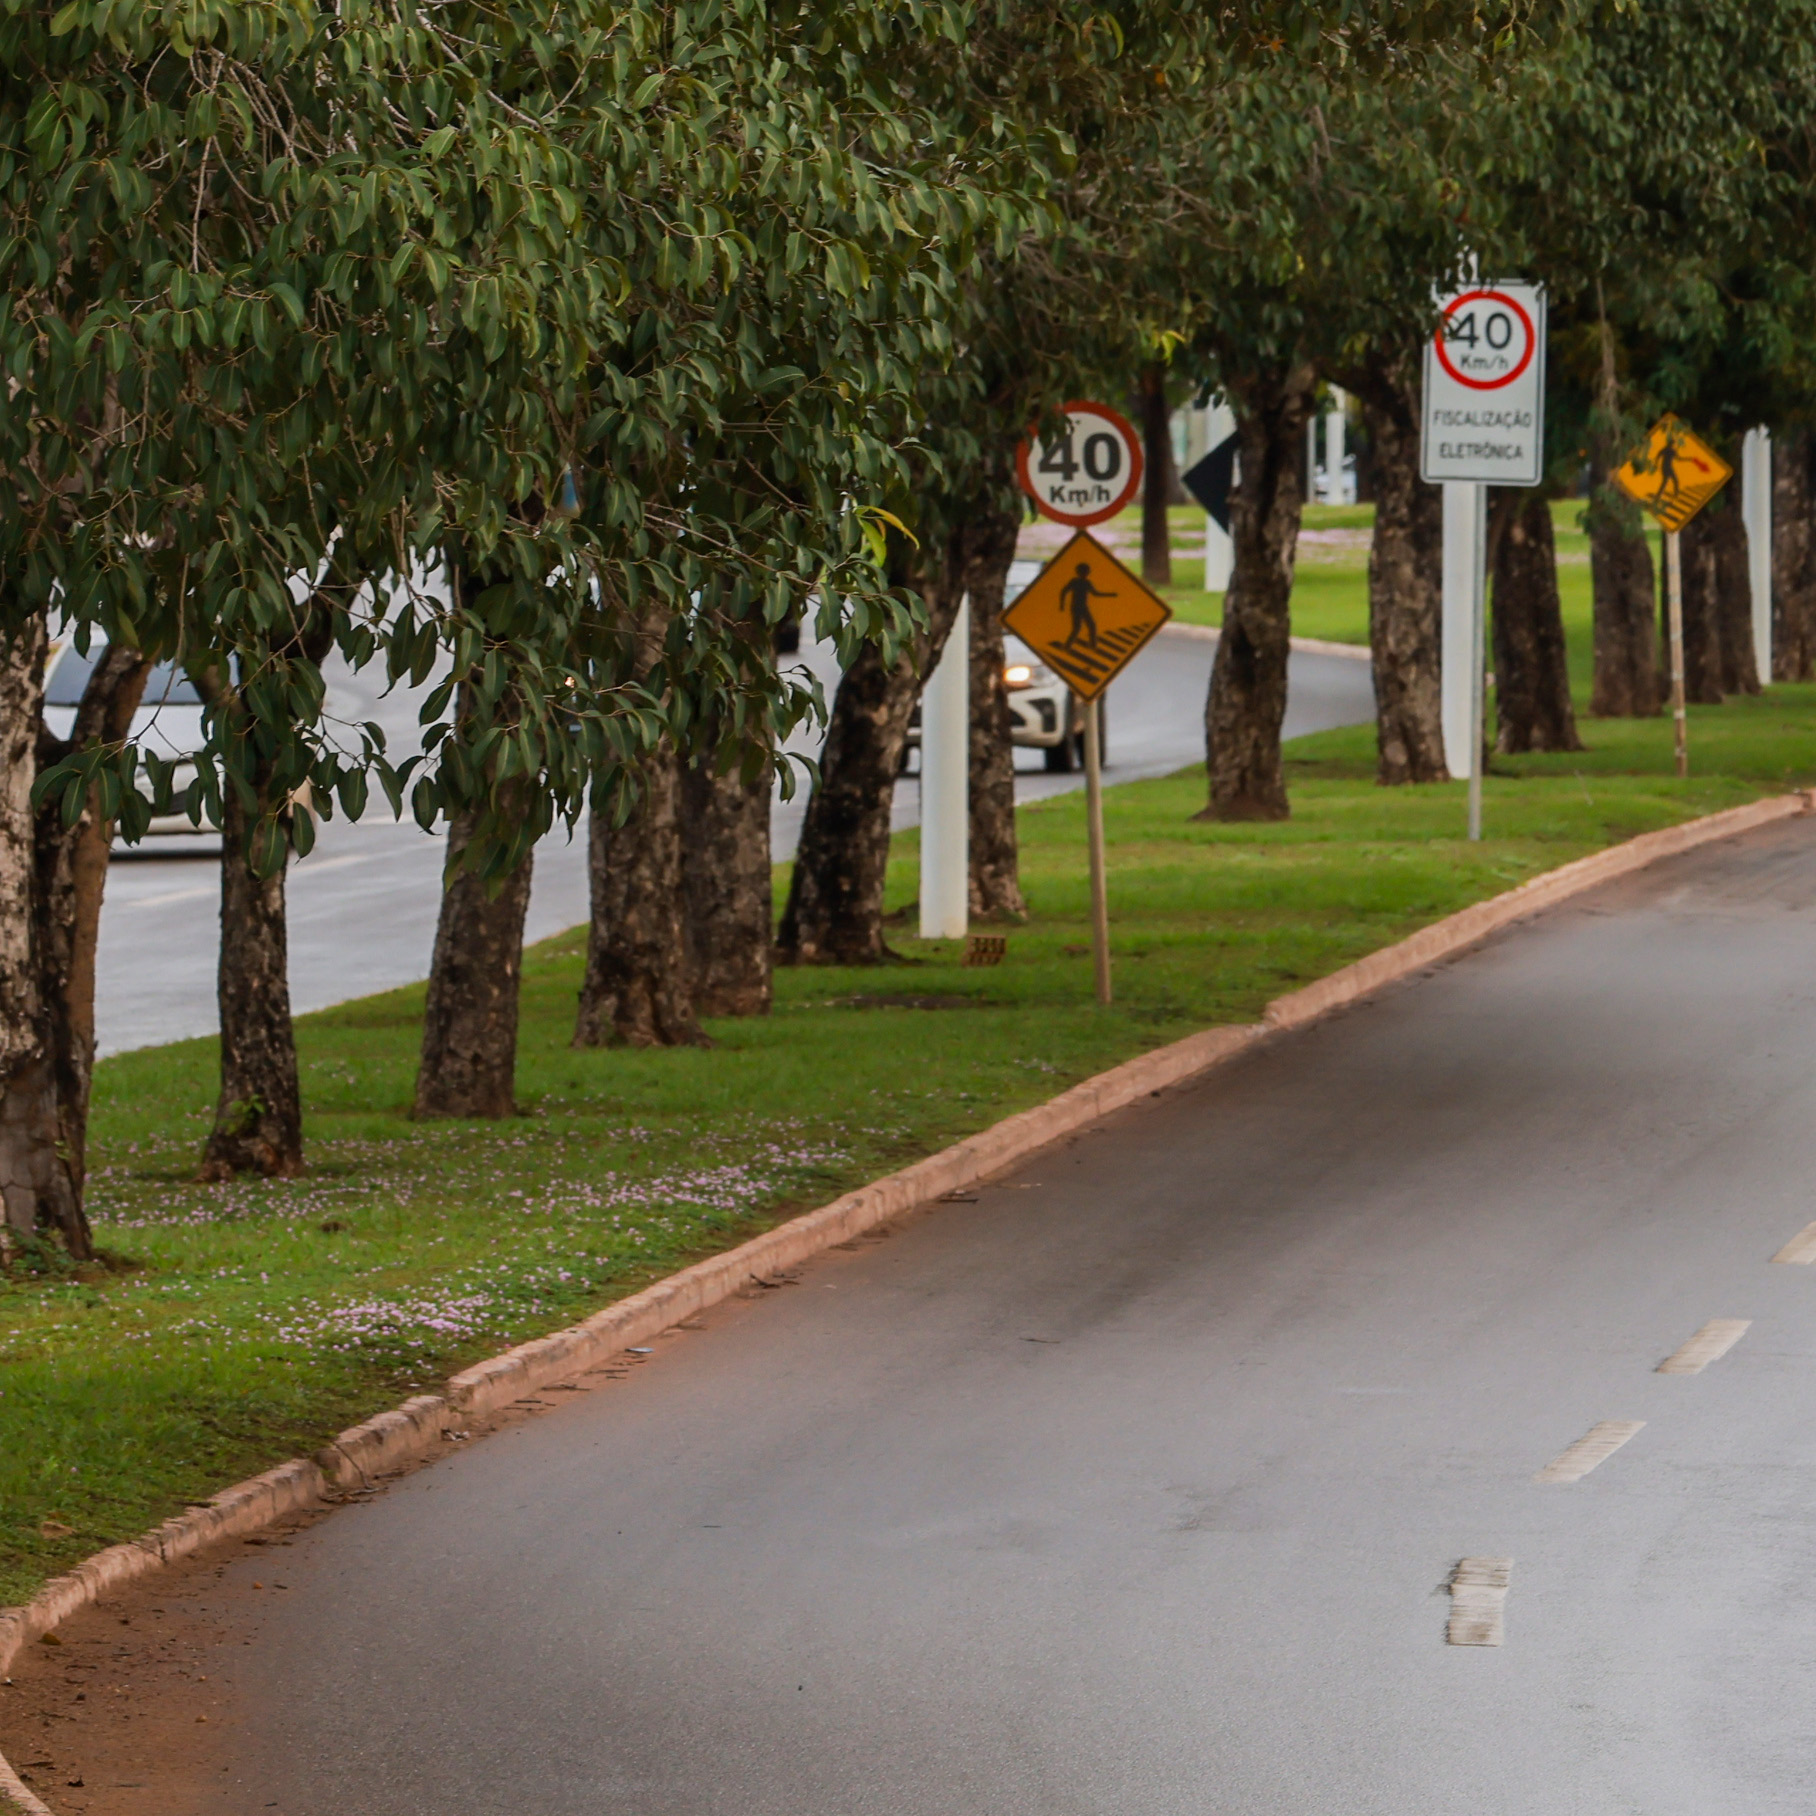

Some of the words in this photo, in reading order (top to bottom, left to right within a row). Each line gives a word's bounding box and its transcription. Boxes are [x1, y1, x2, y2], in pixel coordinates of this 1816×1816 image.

[1453, 311, 1512, 350] 40
[1460, 355, 1509, 370] Km/h
[1434, 407, 1532, 430] FISCALIZAÇÃO
[1038, 432, 1122, 482] 40
[1439, 441, 1524, 460] ELETRÔNICA
[1049, 485, 1111, 503] Km/h
